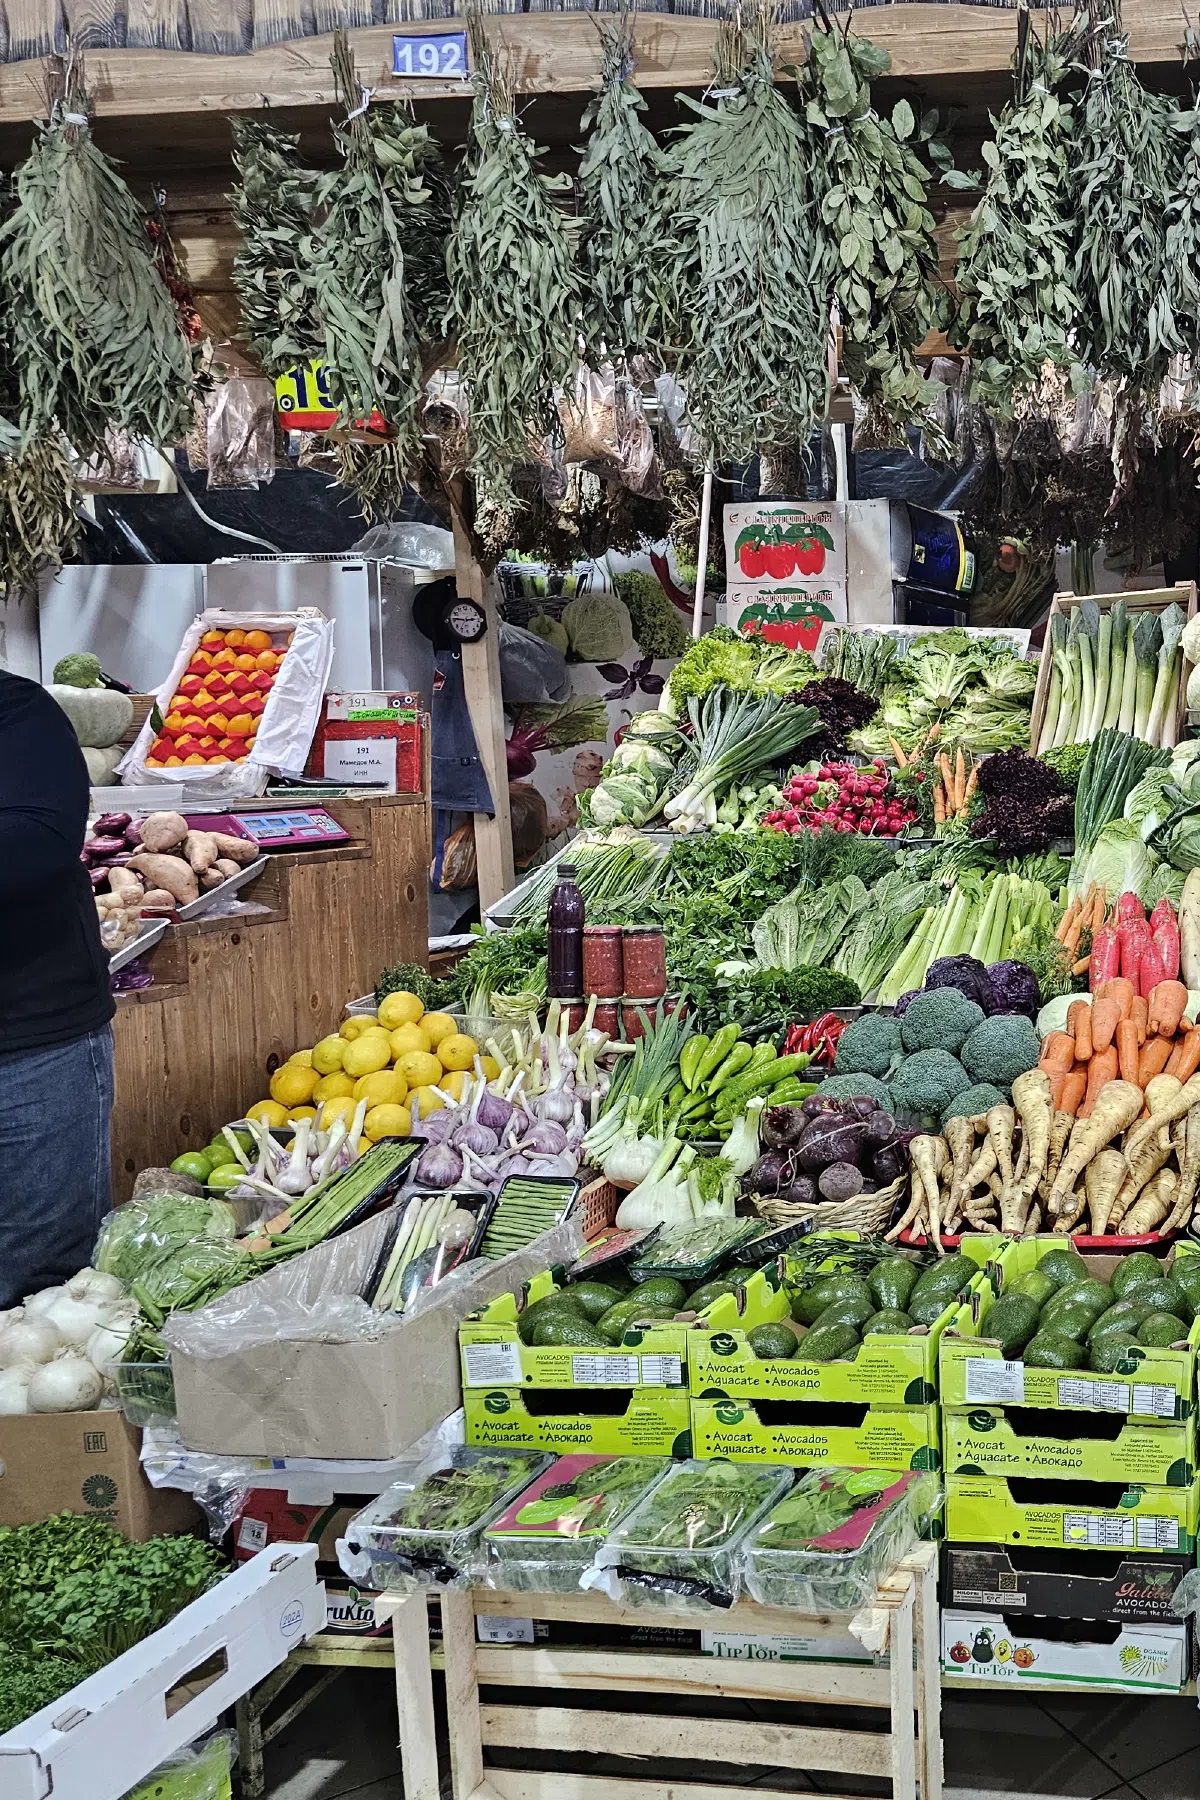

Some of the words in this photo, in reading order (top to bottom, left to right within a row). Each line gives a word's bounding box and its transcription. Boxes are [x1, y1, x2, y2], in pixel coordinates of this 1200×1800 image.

[398, 42, 462, 74] 192
[706, 1362, 746, 1373] Avocat
[769, 1365, 820, 1376] Avocados
[707, 1374, 760, 1387] Aguacate
[1024, 1376, 1056, 1384] VOCADOS
[482, 1420, 520, 1431] Avocat
[543, 1421, 592, 1432] Avocados
[482, 1432, 535, 1445] Aguacate
[713, 1432, 753, 1443] Avocat
[777, 1434, 828, 1444] Avocados
[713, 1444, 767, 1456] Aguacate
[964, 1438, 1006, 1450] Avocat
[1030, 1443, 1083, 1455] Avocados
[964, 1451, 1020, 1464] Aguacate
[1025, 1511, 1061, 1519] AVOCADOS
[251, 1529, 262, 1538] 18
[1116, 1599, 1173, 1609] AVOCADOS
